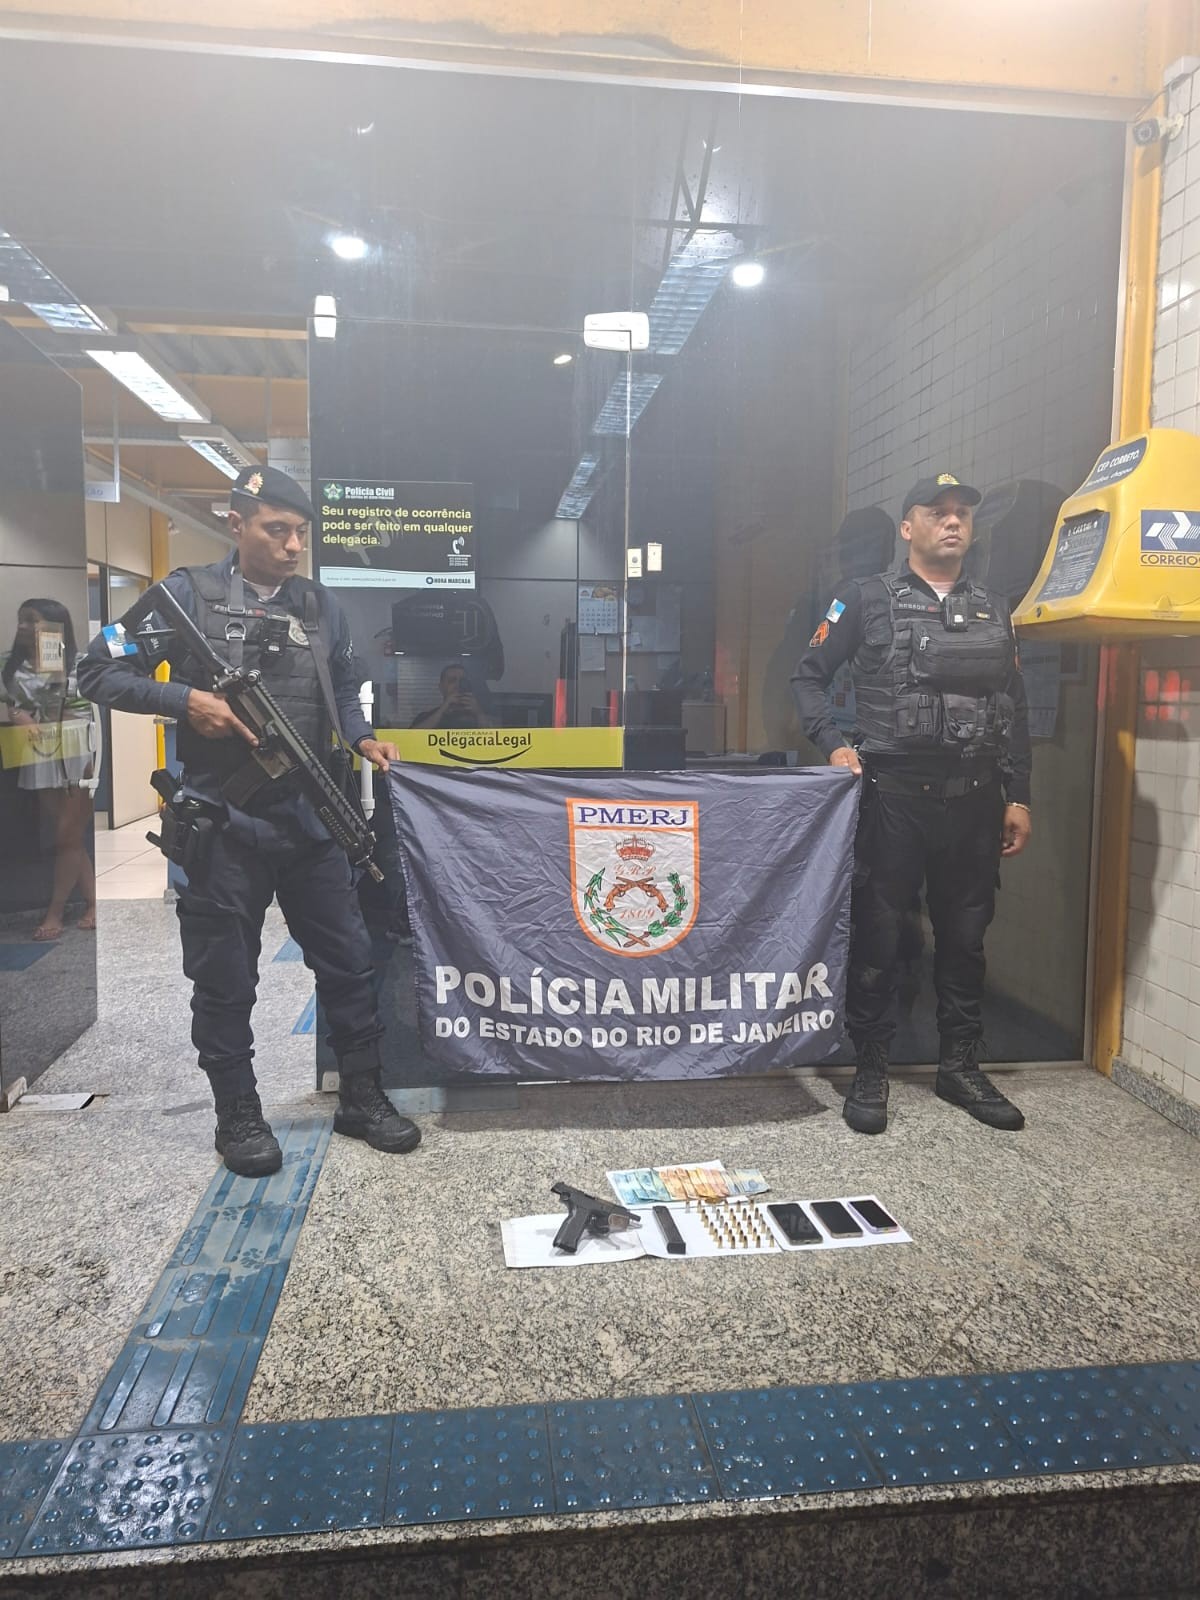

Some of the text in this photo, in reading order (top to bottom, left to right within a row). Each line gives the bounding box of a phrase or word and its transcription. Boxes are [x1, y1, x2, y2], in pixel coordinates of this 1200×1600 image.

[344, 486, 395, 497] Polícia Civil
[322, 505, 472, 519] Seu registro de ocorrência
[322, 520, 473, 535] pode ser feito em qualquer
[322, 533, 381, 546] delegacia.
[1140, 554, 1200, 566] CORREIO
[577, 806, 689, 826] PMERJ
[435, 961, 833, 1015] POLÍCIA MILITAR
[435, 1009, 836, 1049] DO ESTADO DO RIO DE JANEIRO
